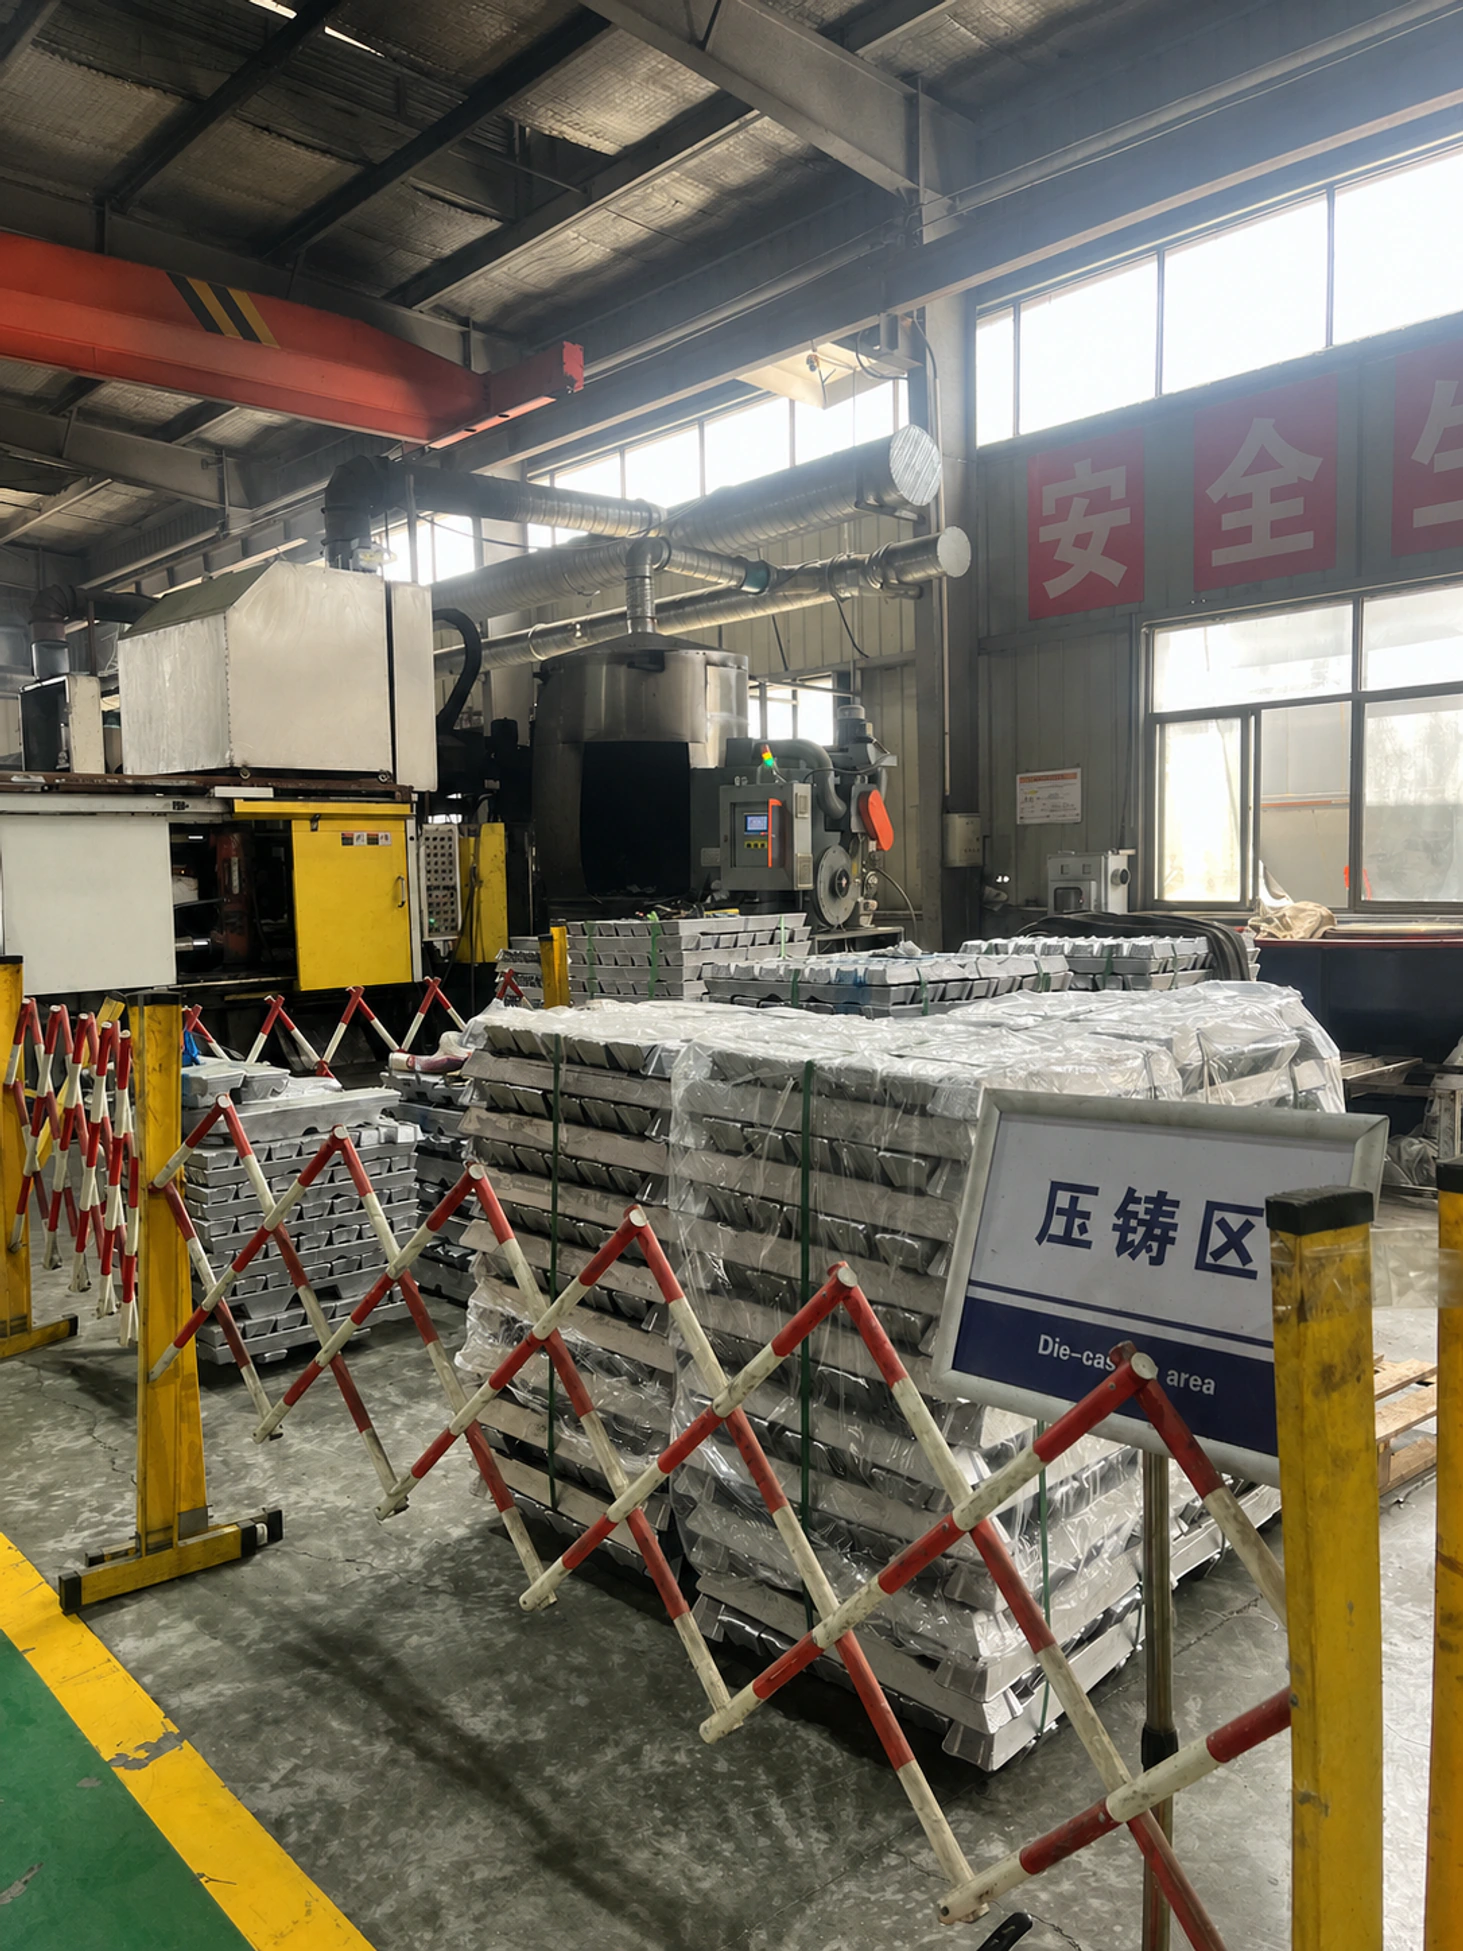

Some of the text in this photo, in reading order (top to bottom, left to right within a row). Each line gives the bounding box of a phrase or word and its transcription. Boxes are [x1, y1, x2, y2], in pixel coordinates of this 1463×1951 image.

[1035, 1180, 1265, 1280] 压铸区
[1037, 1333, 1216, 1395] Die-cas area
